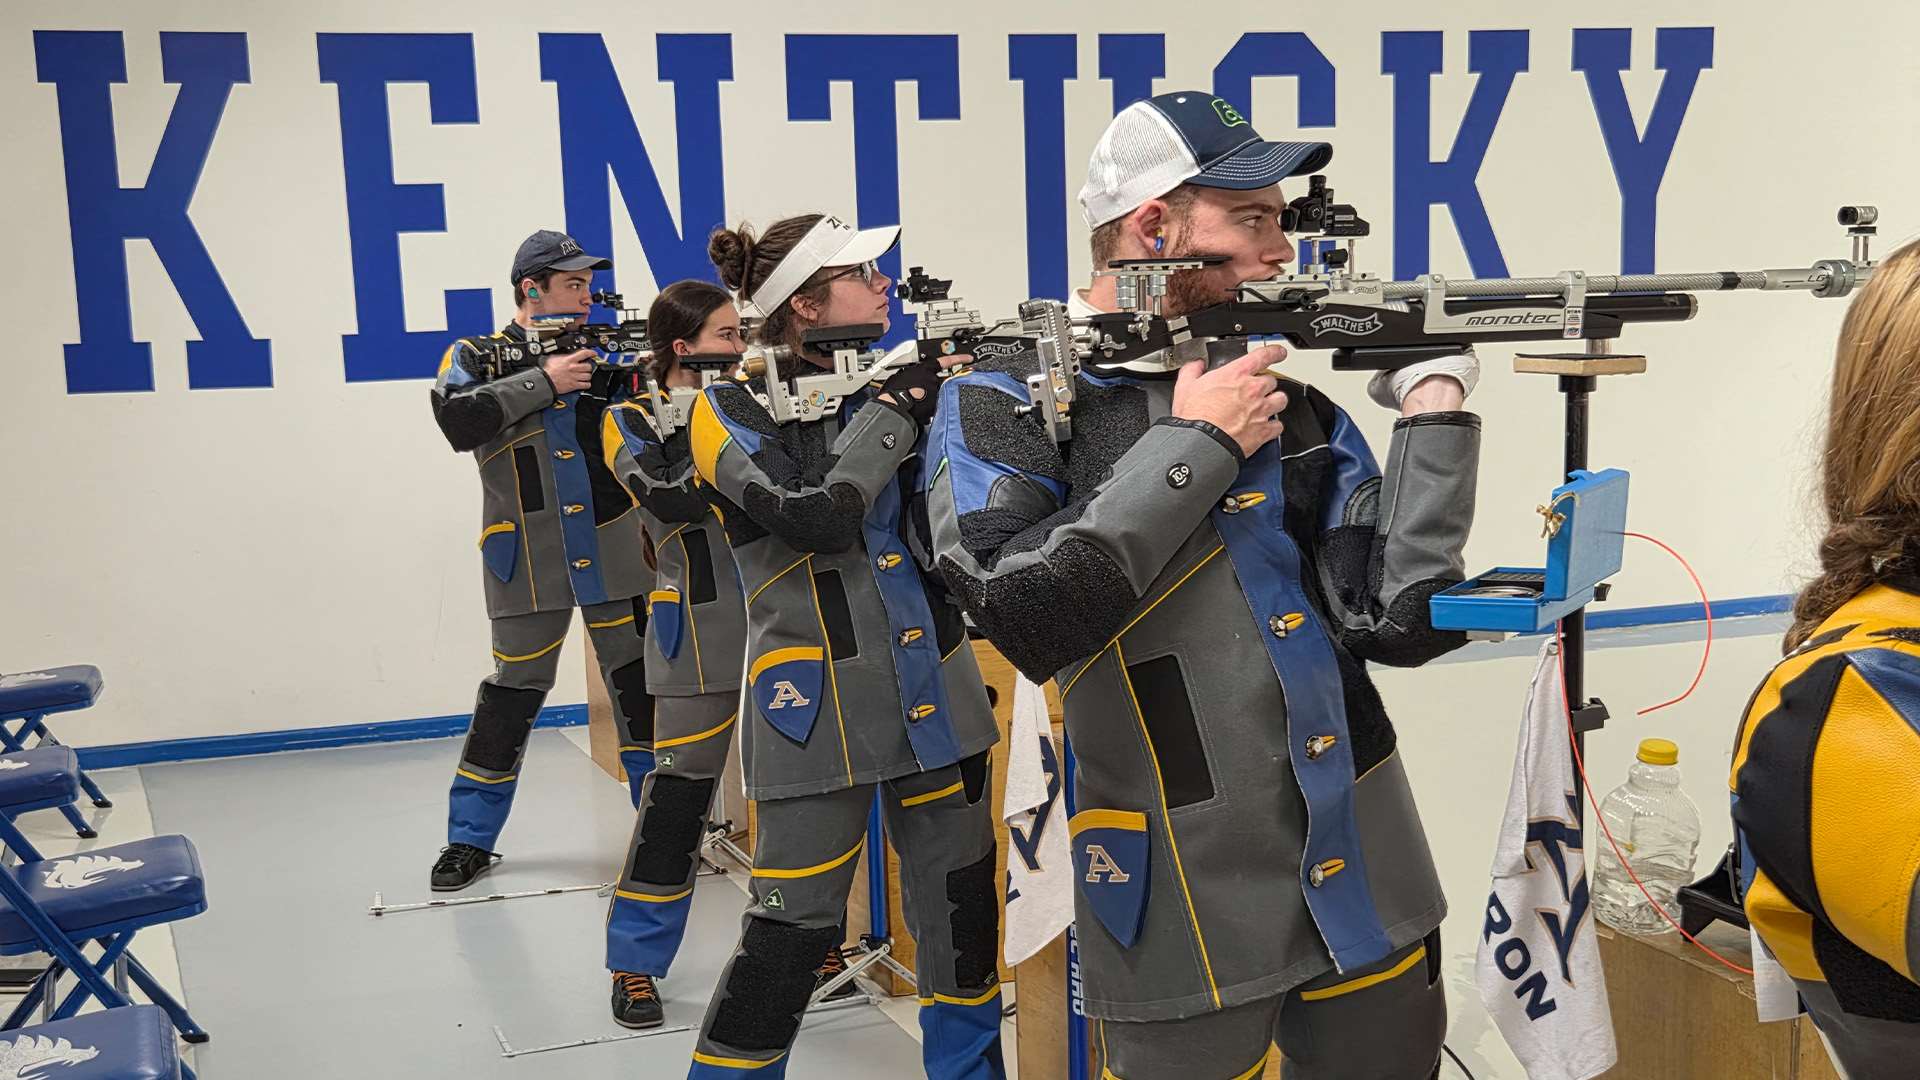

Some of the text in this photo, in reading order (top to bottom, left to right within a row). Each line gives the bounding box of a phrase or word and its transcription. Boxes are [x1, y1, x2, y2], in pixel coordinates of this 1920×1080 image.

[1320, 316, 1373, 333] WALTHER
[980, 344, 1017, 354] WALTHER
[1172, 465, 1189, 482] 10.9
[768, 680, 810, 710] A
[1085, 844, 1130, 883] A
